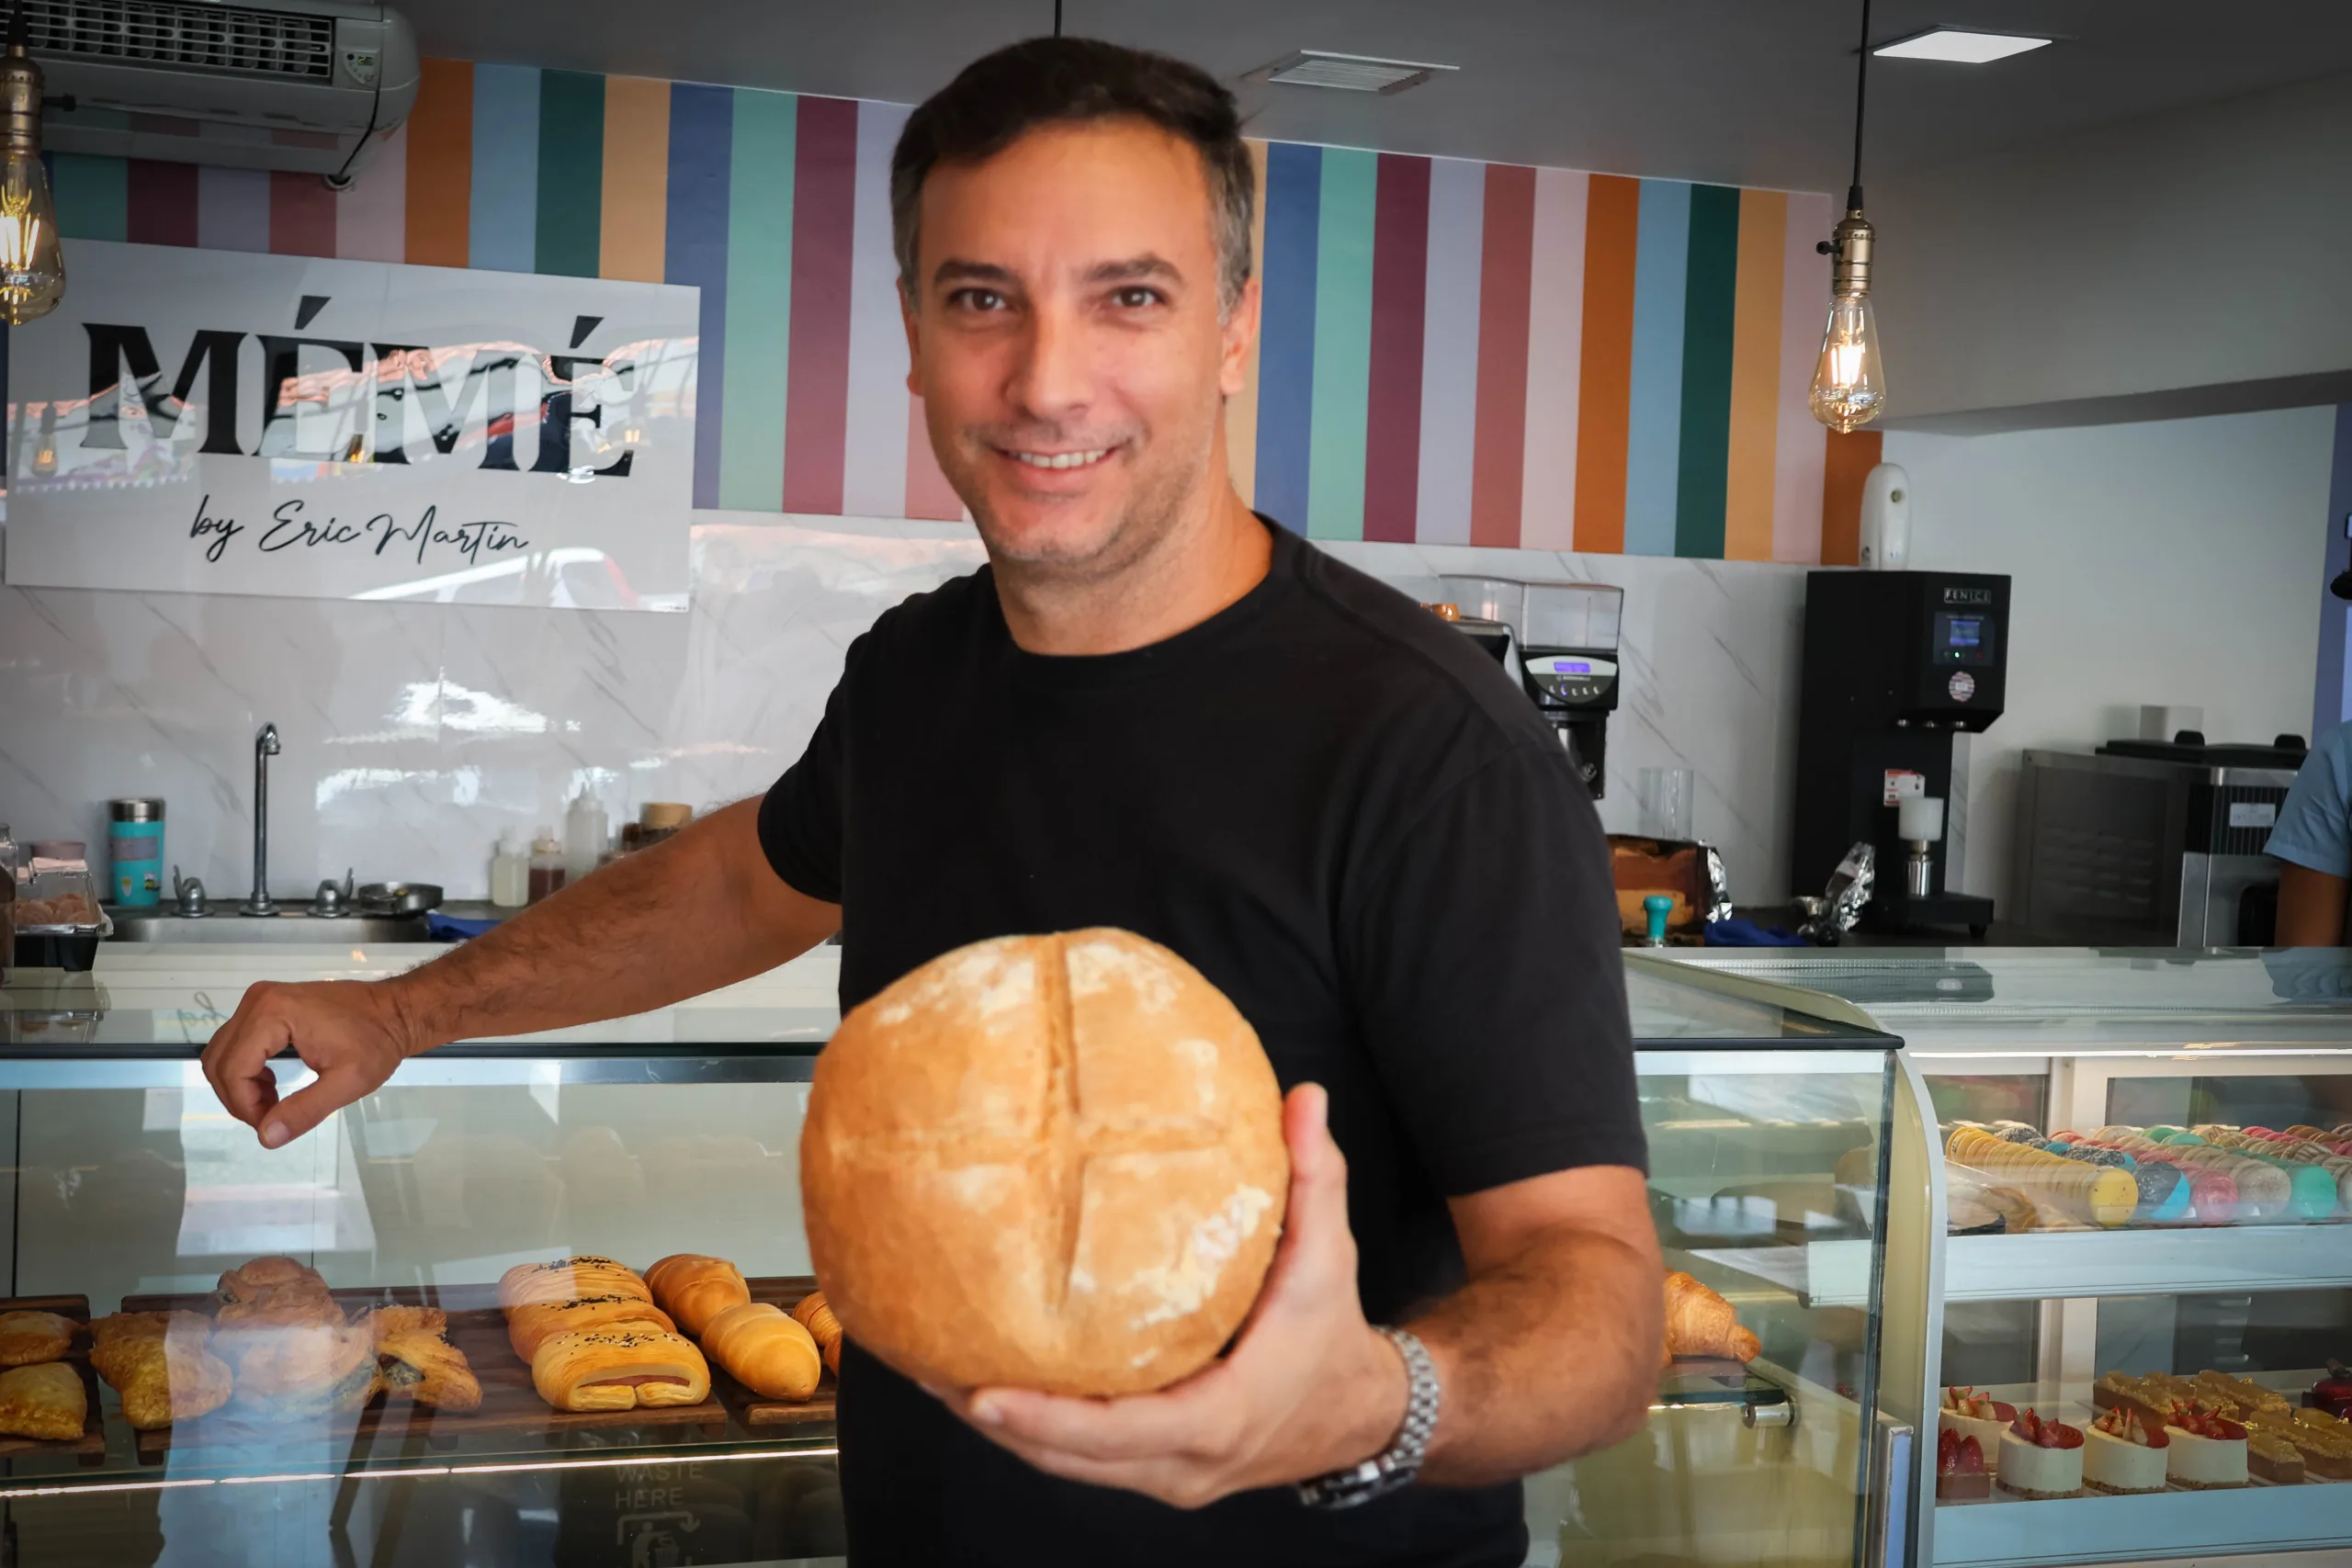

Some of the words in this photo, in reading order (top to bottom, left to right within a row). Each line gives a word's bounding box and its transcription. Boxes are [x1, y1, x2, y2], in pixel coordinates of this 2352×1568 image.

[82, 295, 635, 477] MÉMÉ
[189, 493, 244, 563] by
[258, 500, 362, 552] Eric
[366, 504, 530, 565] Martin
[616, 1461, 704, 1483] WASTE
[615, 1486, 684, 1509] HERE
